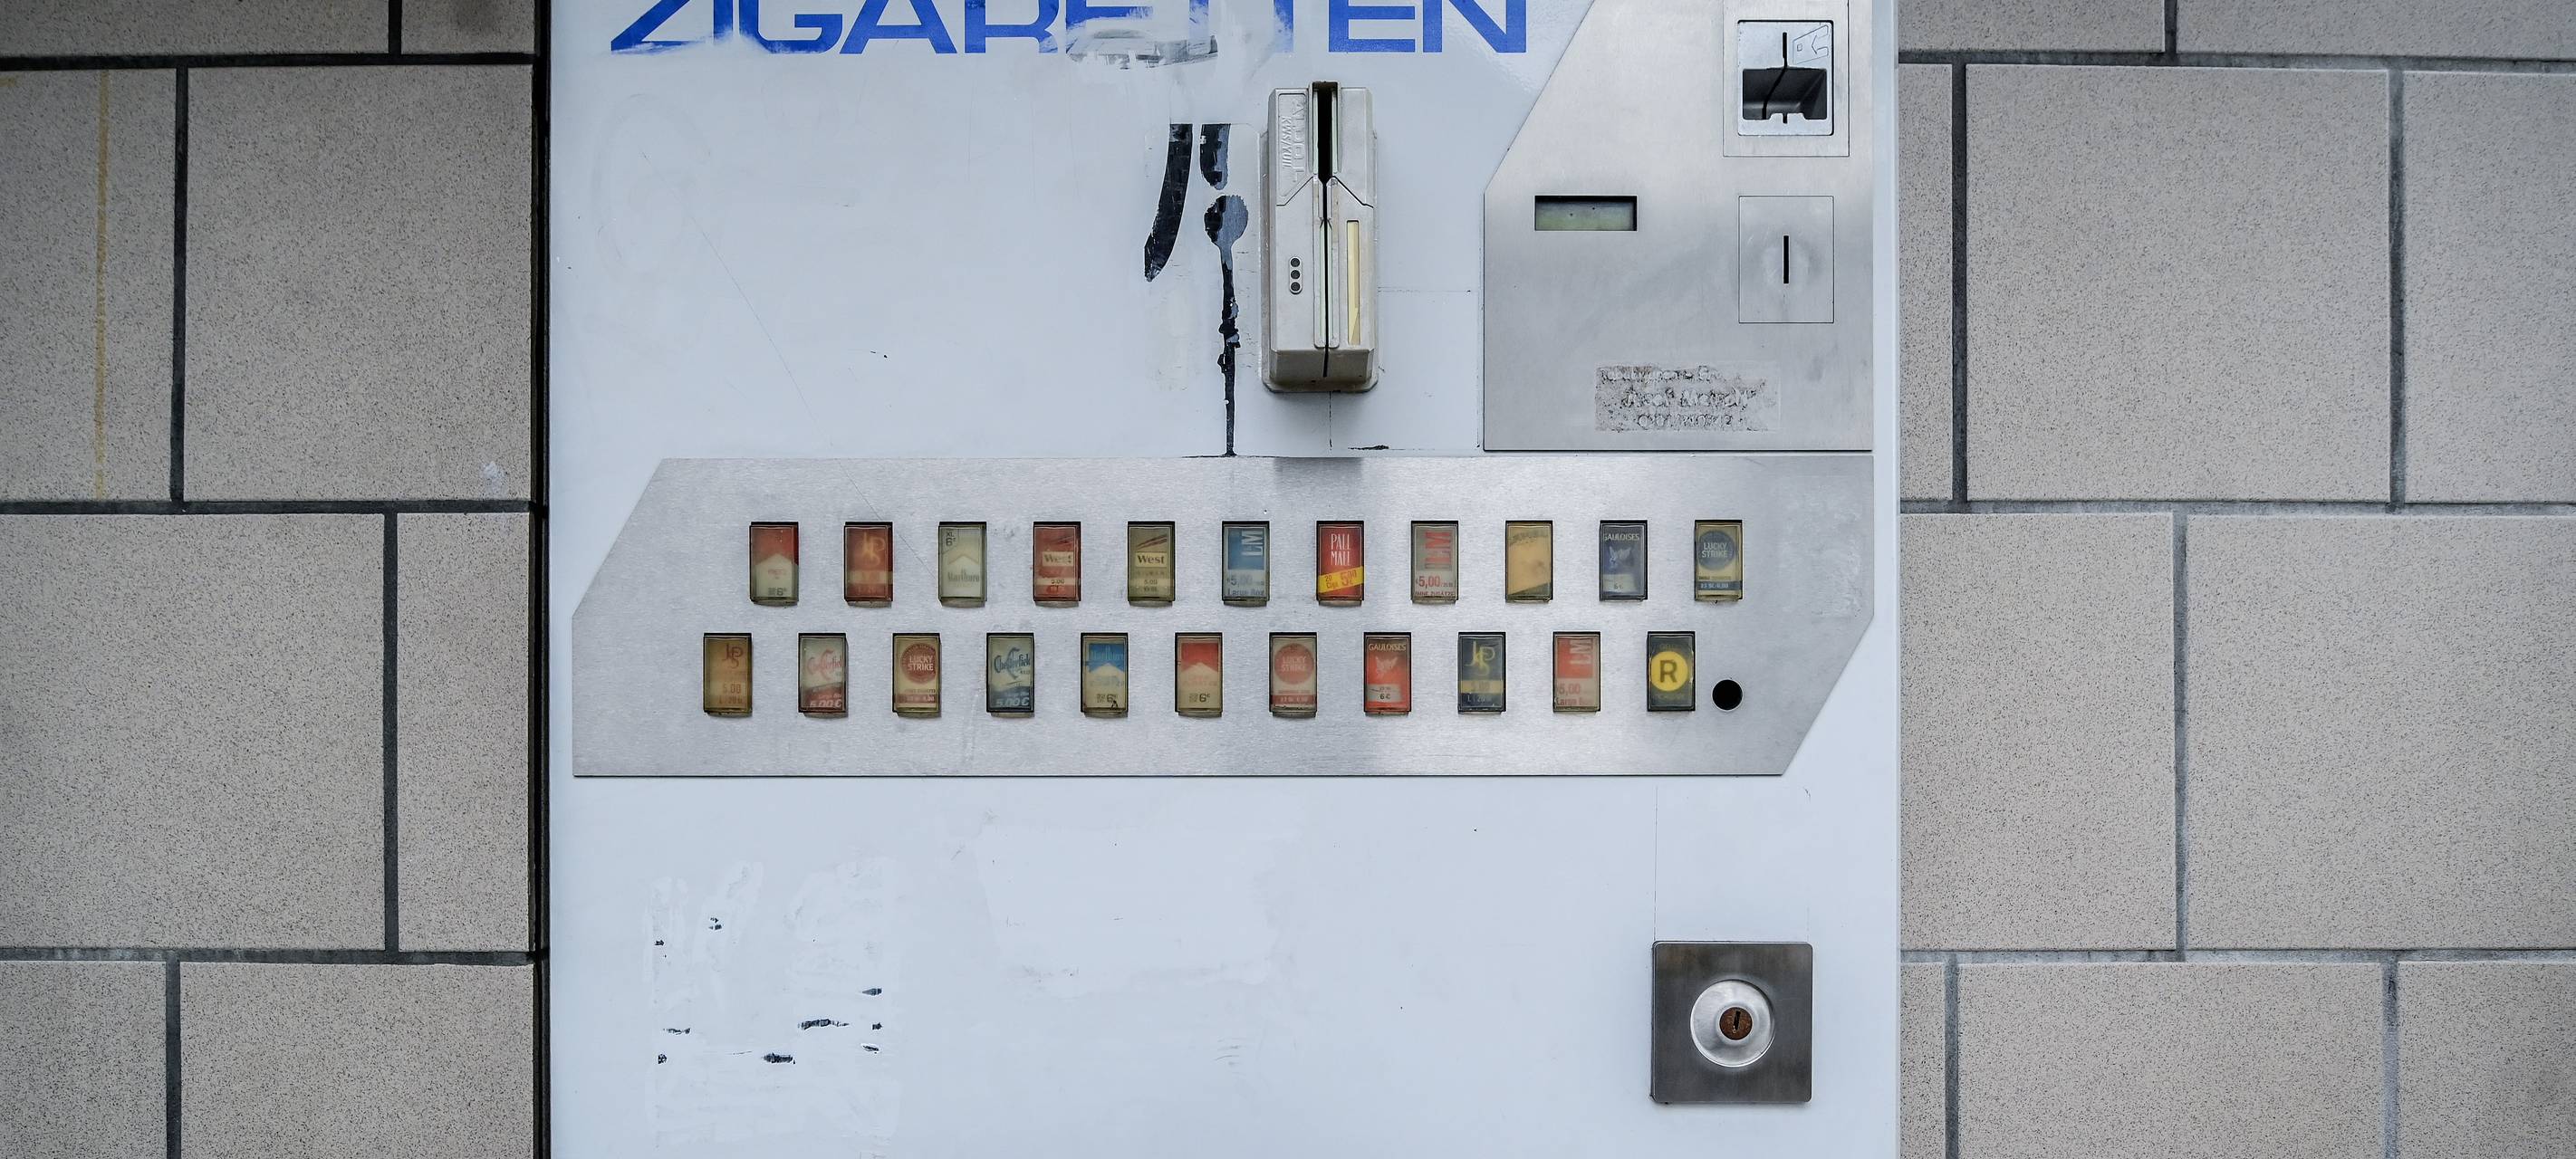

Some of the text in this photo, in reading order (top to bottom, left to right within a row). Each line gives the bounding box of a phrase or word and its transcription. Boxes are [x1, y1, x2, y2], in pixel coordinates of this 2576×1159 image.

[610, 0, 1527, 54] ZIGAREN
[1331, 532, 1350, 550] PALL
[1703, 542, 1727, 551] LUCKY
[1331, 551, 1350, 566] MALL
[1701, 550, 1729, 558] STRIKE
[1137, 555, 1165, 564] West
[1369, 643, 1406, 651] GAULOISES
[908, 663, 934, 671] STRIKE
[1659, 659, 1678, 683] R
